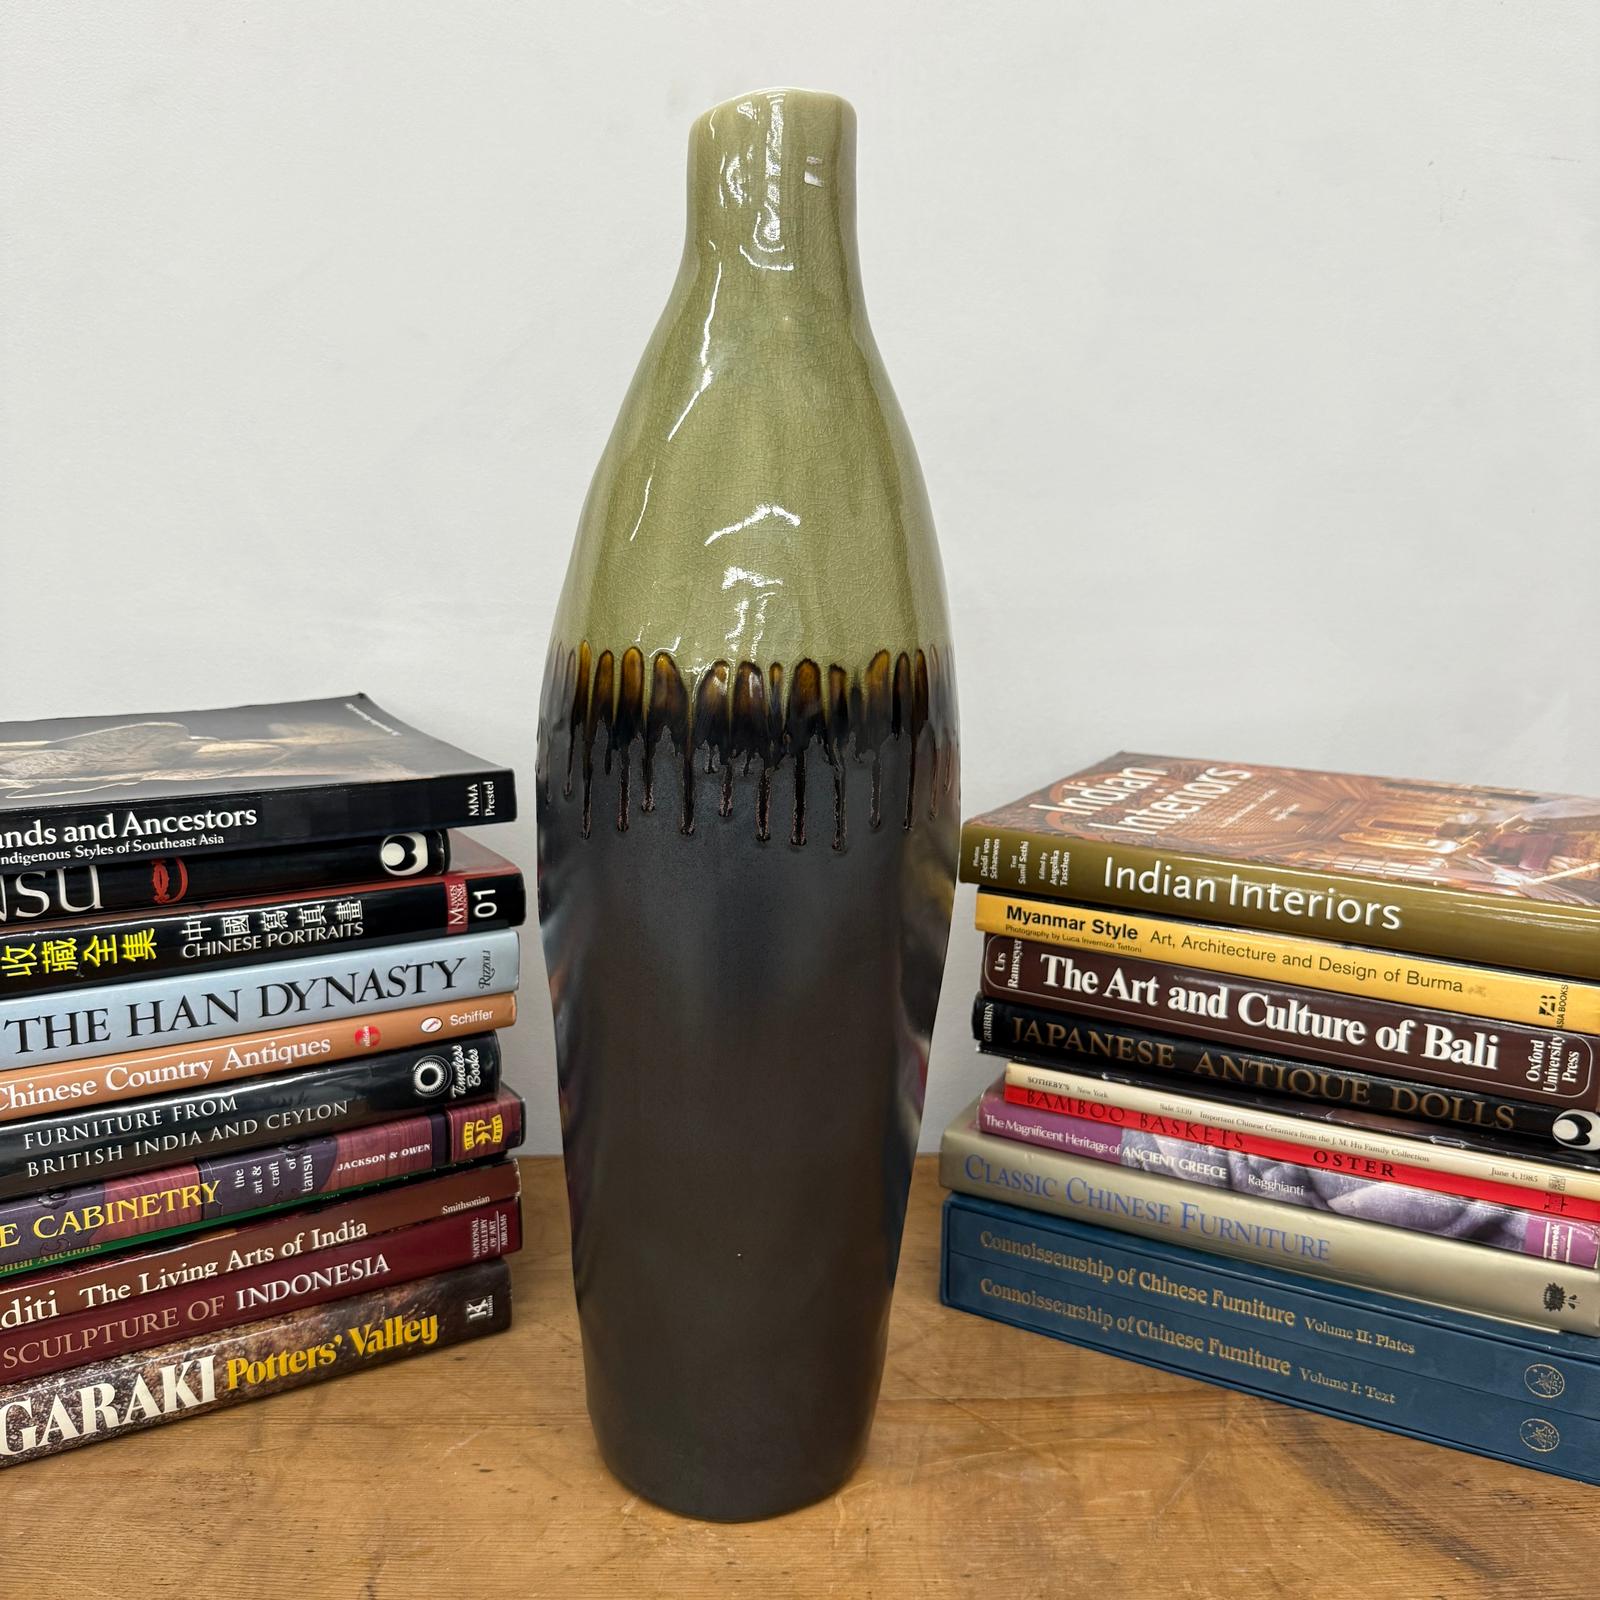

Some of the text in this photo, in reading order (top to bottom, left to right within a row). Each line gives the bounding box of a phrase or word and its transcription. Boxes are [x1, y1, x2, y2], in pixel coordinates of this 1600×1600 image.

[467, 783, 480, 816] MMA
[484, 781, 495, 816] Prestel
[1029, 767, 1168, 815] Indian
[1088, 767, 1251, 835] Interiors
[64, 813, 117, 842] and
[122, 809, 257, 837] Ancestors
[75, 844, 114, 859] Styles
[116, 841, 131, 854] of
[133, 836, 197, 852] Southeast
[199, 834, 225, 846] Asia
[990, 838, 1000, 880] Schaewen
[1018, 841, 1029, 885] Sunil Sethi
[1050, 850, 1060, 886] Angelika
[1060, 851, 1070, 886] Taschen
[473, 888, 498, 918] 01
[1104, 857, 1402, 931] Indian Interiors
[1, 928, 158, 977] 收藏全集
[183, 922, 364, 958] CHINESE PORTRAITS
[1005, 925, 1050, 938] Photography
[1051, 932, 1061, 941] by
[1062, 934, 1080, 943] Luca
[1081, 937, 1116, 949] Invernizzi
[1006, 905, 1463, 993] Myanmar Style Art, Architecture and Design of Burma
[994, 952, 1006, 972] Urs
[4, 957, 467, 1054] THE HAN DYNASTY
[1040, 953, 1500, 1071] The Art and Culture of Bali
[1558, 984, 1569, 1012] BOOKS
[450, 1010, 494, 1027] Schiffer
[983, 1002, 994, 1042] GRIBBIN
[106, 1059, 213, 1092] Country
[223, 1038, 332, 1071] Antiques
[451, 1044, 466, 1098] Timeless
[466, 1048, 480, 1087] Books
[1012, 1017, 1516, 1130] JAPANESE ANTIQUE DOLLS
[1525, 1039, 1545, 1082] Oxford
[1543, 1034, 1566, 1093] University
[1562, 1051, 1580, 1083] Press
[1027, 1076, 1108, 1097] SOTHEBY'S New York
[24, 1096, 239, 1149] FURNITURE FROM
[1026, 1089, 1244, 1148] BAMBOO BASKETS
[1200, 1111, 1235, 1125] Important
[1236, 1118, 1264, 1130] Chinese
[1265, 1124, 1298, 1137] Ceramics
[1299, 1131, 1317, 1141] from
[1318, 1135, 1330, 1143] the
[1338, 1138, 1350, 1146] M.
[1350, 1140, 1363, 1149] Hu
[1364, 1143, 1390, 1156] Family
[1391, 1149, 1430, 1162] Collection
[27, 1100, 349, 1178] BRITISH INDIA AND CEYLON
[336, 1143, 430, 1172] JACKSON & OWEN
[985, 1114, 1228, 1179] The Magnificent Heritage of ANCIENT GREECE
[234, 1168, 244, 1188] the
[252, 1165, 263, 1194] art &
[269, 1161, 280, 1187] craft
[286, 1157, 297, 1170] of
[302, 1154, 313, 1192] tansu
[1313, 1150, 1395, 1178] OSTER
[1489, 1167, 1509, 1177] June
[1510, 1171, 1518, 1179] 4,
[1248, 1174, 1304, 1196] Ragghianti
[33, 1180, 221, 1239] CABINETRY
[442, 1196, 491, 1215] Smithsonian
[965, 1154, 1331, 1261] CLASSIC CHINESE FURNITURE
[472, 1217, 481, 1258] NATIONAL
[480, 1218, 488, 1253] GALLERY
[489, 1220, 497, 1247] OF ART
[500, 1213, 508, 1245] ABRAMS
[0, 1219, 369, 1330] diti The Living Arts of India
[980, 1231, 1416, 1354] Connoisseurship of Chinese Furniture Volume II: Plates
[3, 1253, 392, 1369] SCULPTURE OF INDONESIA
[980, 1278, 1396, 1404] Connoisseurship of Chinese Furniture Volume I: Text
[0, 1314, 439, 1456] GARAKI Potters' Valley
